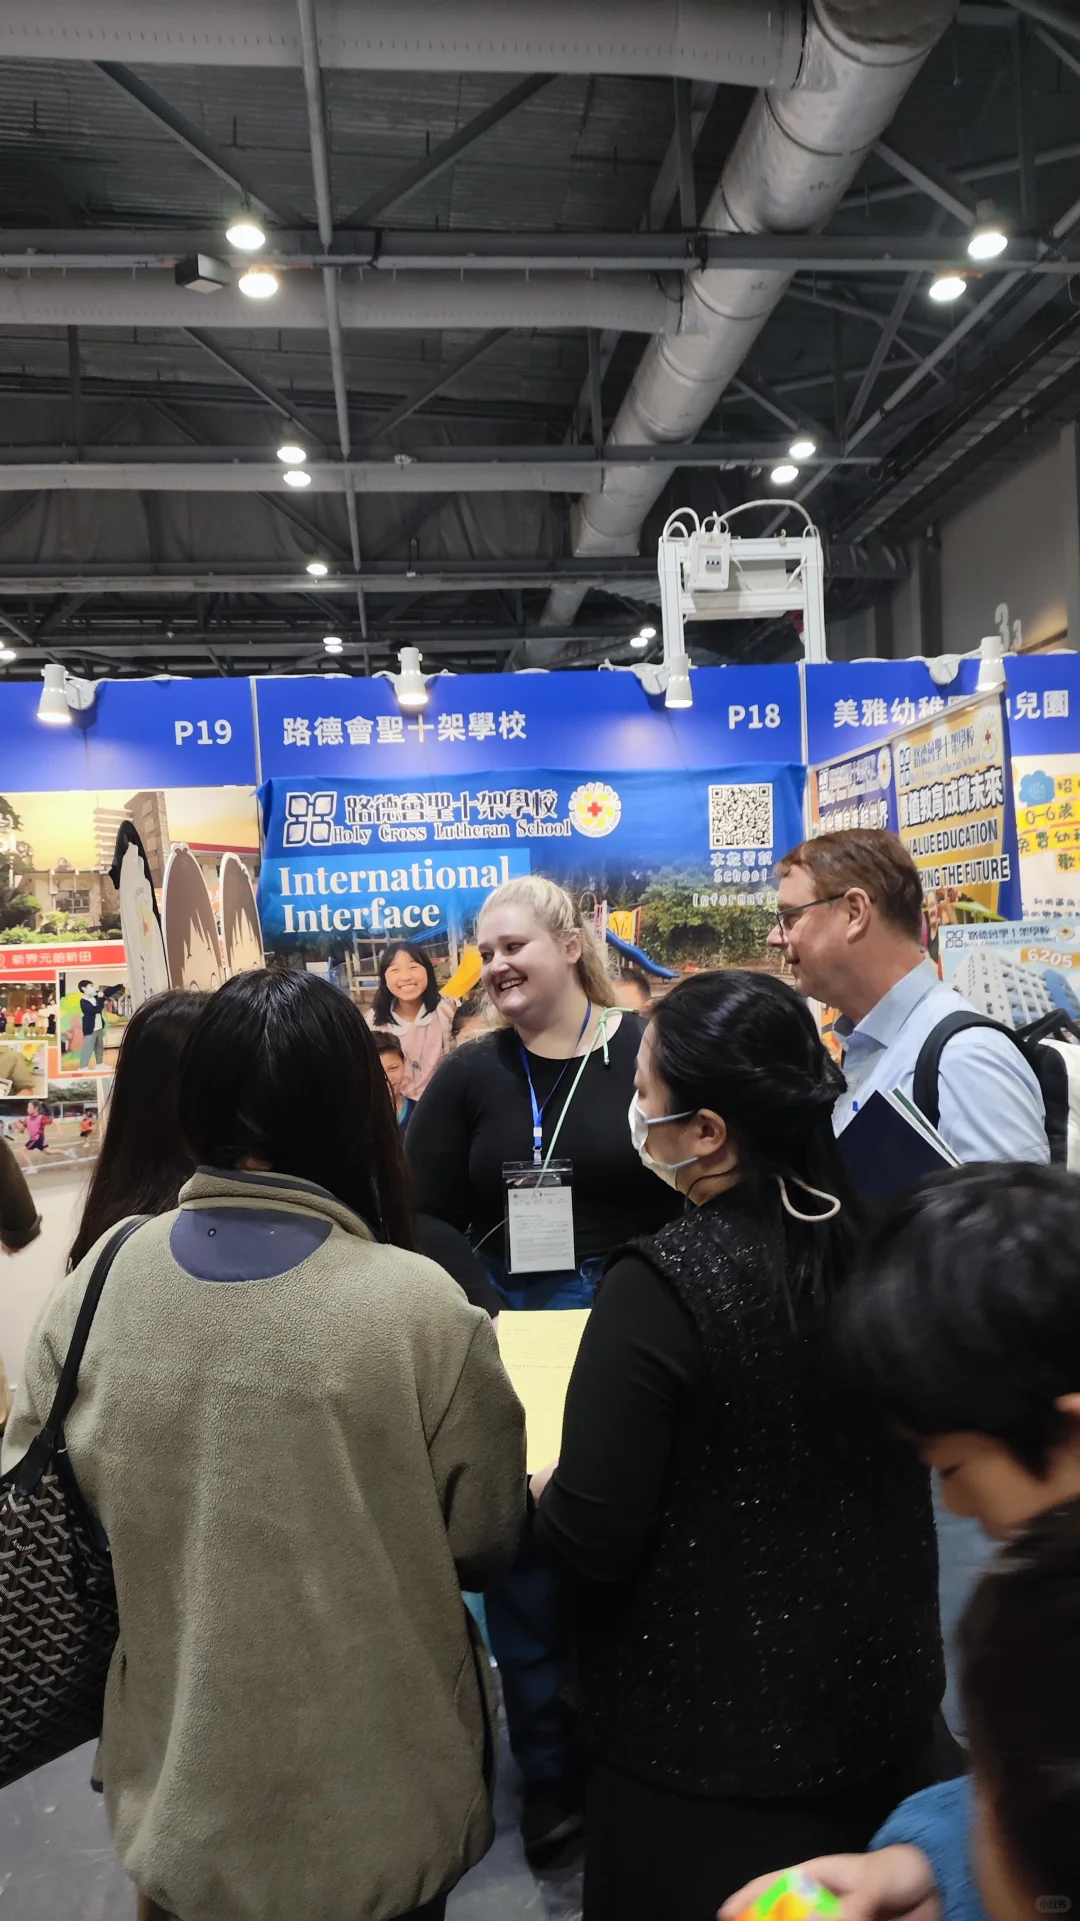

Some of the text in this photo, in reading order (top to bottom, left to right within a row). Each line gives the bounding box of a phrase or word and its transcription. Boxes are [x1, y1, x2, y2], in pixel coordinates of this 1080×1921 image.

[283, 710, 527, 747] 路德會聖十架學校
[728, 704, 781, 730] P18
[174, 719, 232, 745] P19
[1057, 778, 1080, 794] 招
[344, 789, 558, 824] 路德會聖十架學校
[332, 825, 371, 845] Holy
[379, 824, 426, 841] Cross
[434, 822, 510, 841] Lutheran
[516, 818, 571, 837] School
[936, 819, 998, 852] EDUCATION
[279, 855, 510, 897] International
[713, 868, 768, 883] School
[942, 864, 963, 885] THE
[965, 856, 1010, 883] FUTURE
[282, 898, 440, 933] Interface
[1027, 948, 1073, 969] 6205
